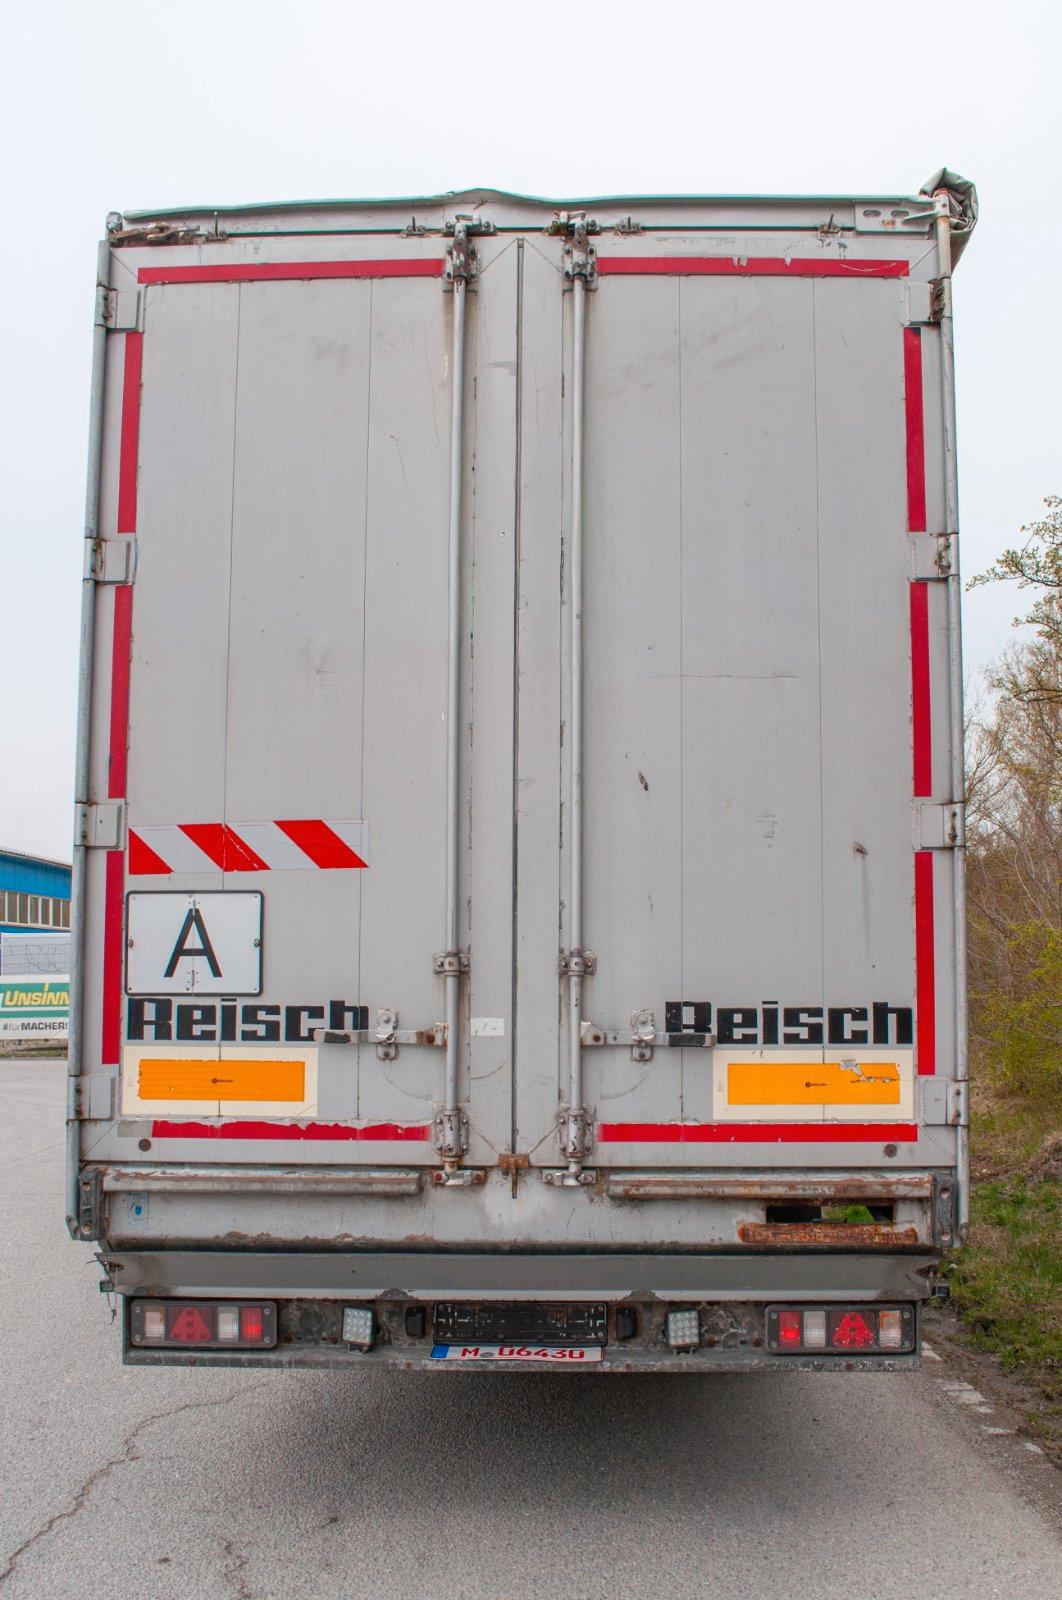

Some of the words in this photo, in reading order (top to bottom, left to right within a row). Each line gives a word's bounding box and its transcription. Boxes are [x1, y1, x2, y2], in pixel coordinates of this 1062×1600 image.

[163, 908, 223, 978] A
[127, 998, 369, 1042] Reisch
[665, 1001, 913, 1045] Reisch
[460, 1347, 480, 1357] M
[498, 1346, 585, 1359] 06430
